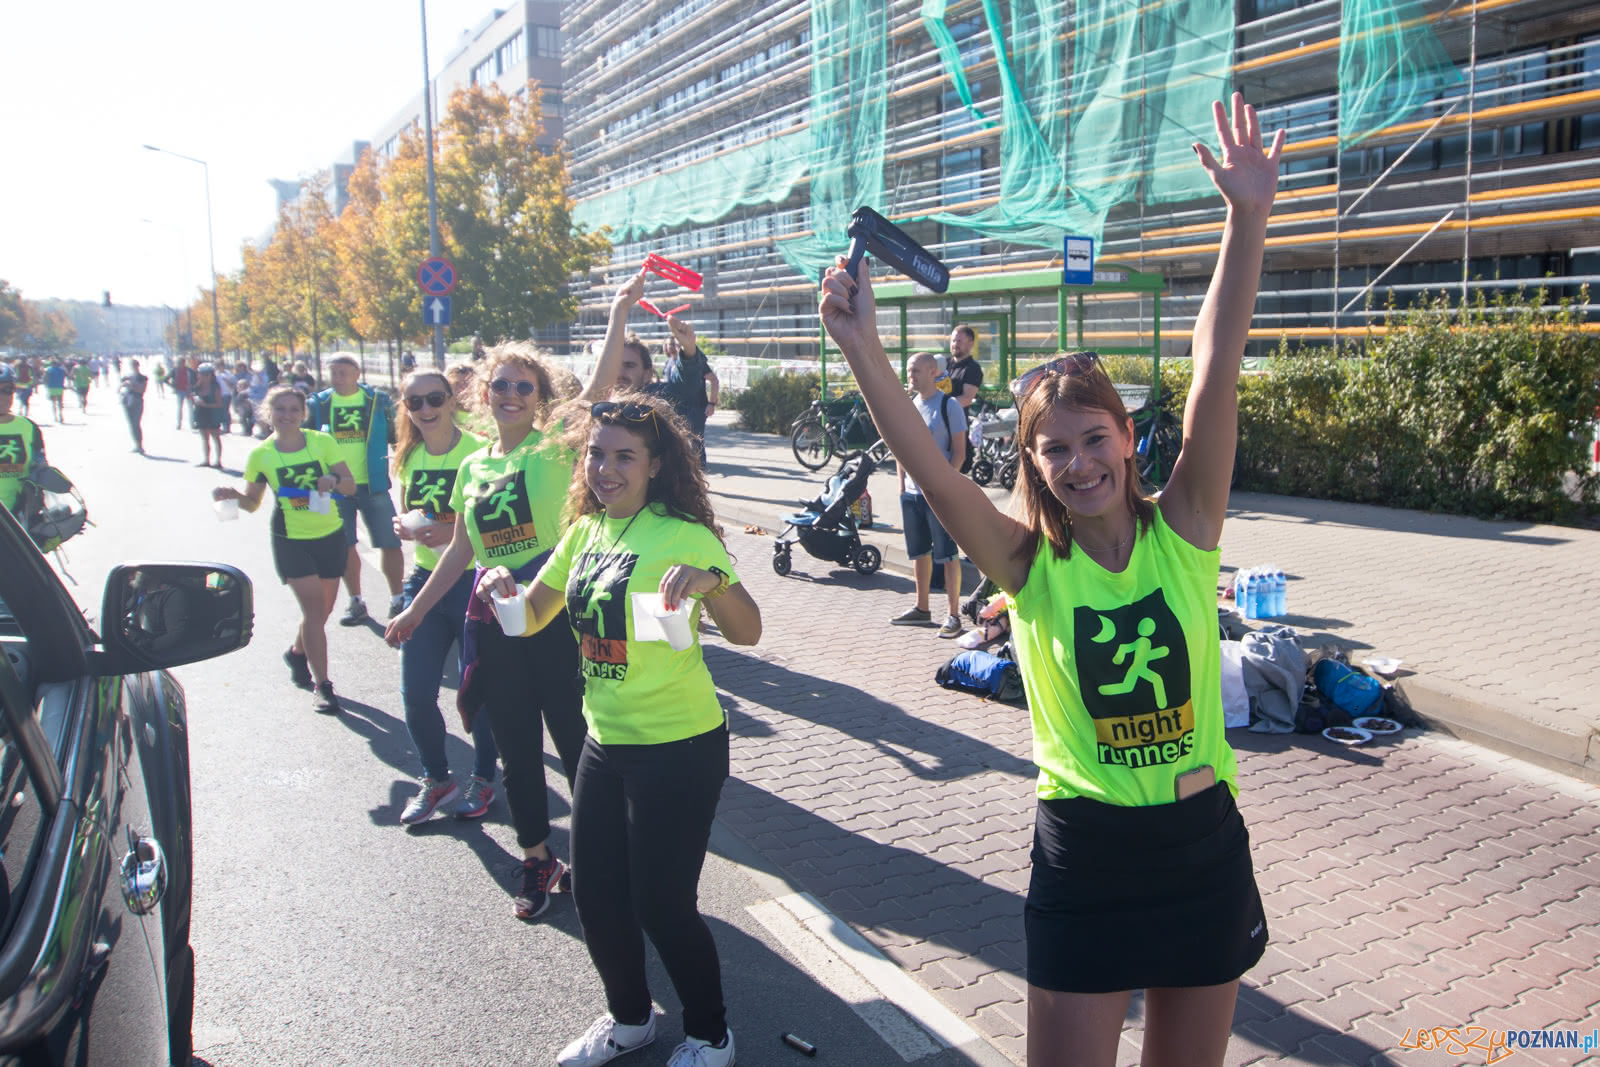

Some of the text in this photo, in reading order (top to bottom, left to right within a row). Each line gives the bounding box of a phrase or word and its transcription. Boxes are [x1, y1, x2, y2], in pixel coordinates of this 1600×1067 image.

[486, 537, 538, 558] runners
[491, 526, 526, 545] night
[1111, 709, 1182, 743] night
[1098, 731, 1194, 768] runners
